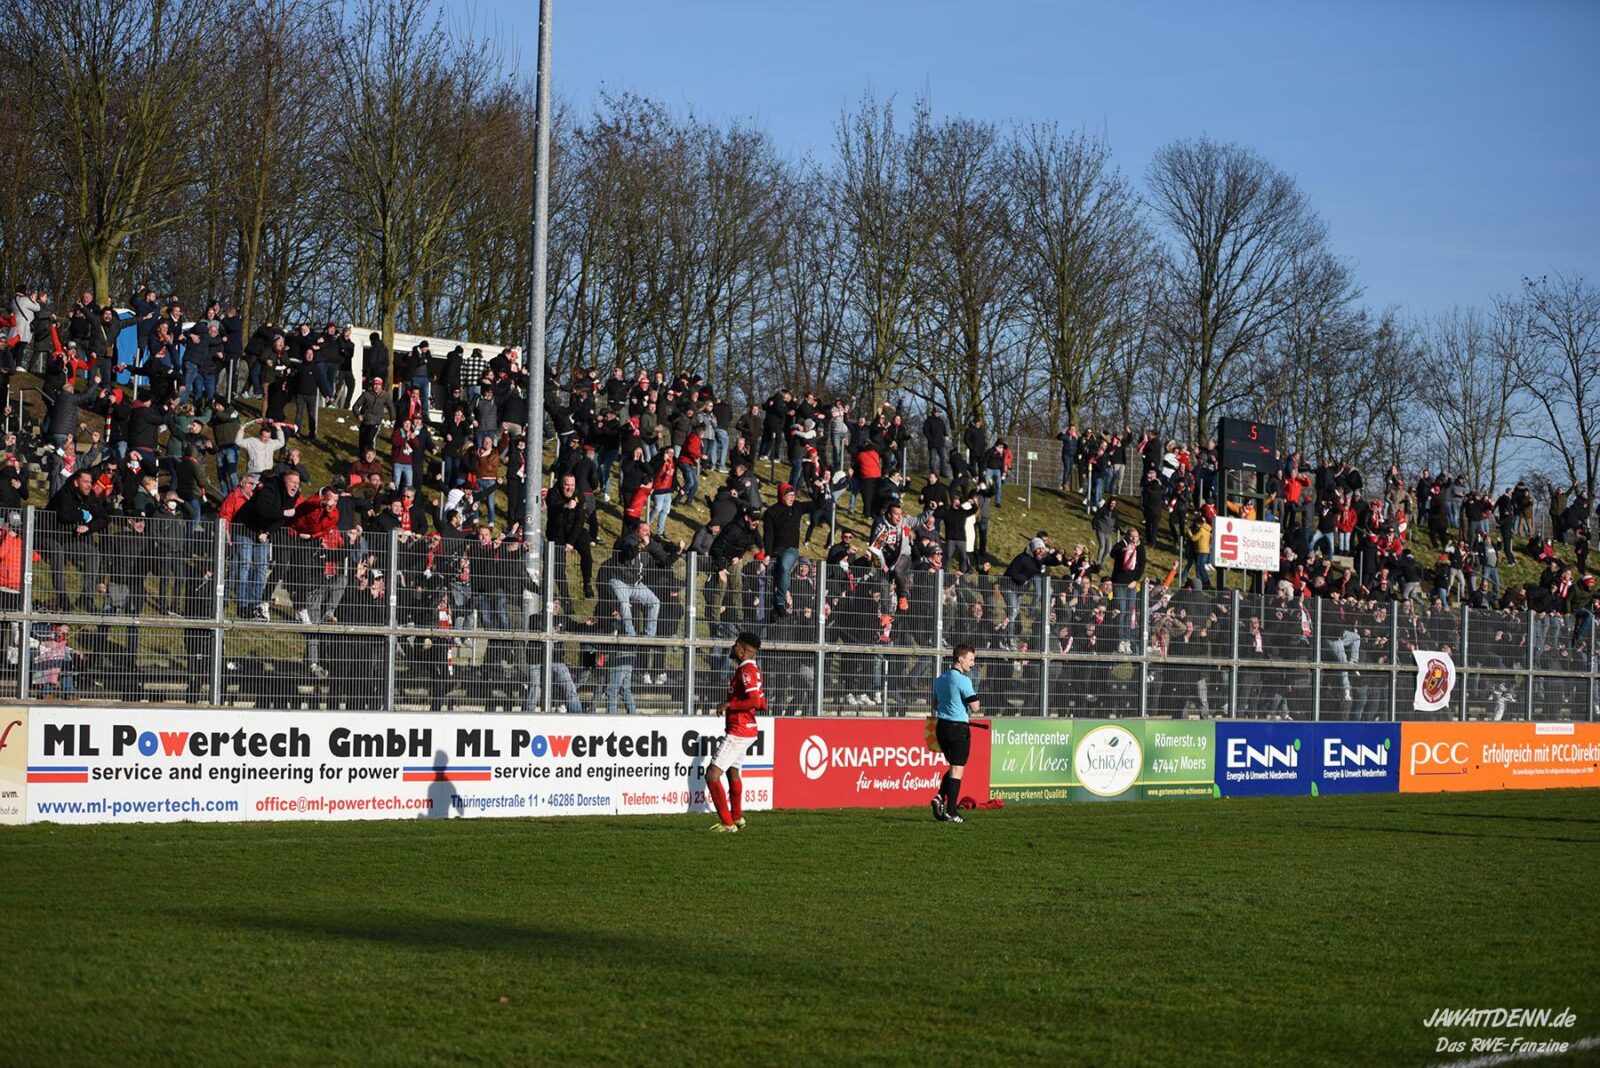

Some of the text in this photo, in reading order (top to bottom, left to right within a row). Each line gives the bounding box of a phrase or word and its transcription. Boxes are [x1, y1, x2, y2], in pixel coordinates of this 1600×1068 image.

[1242, 536, 1276, 550] Sparkasse
[43, 724, 100, 757] ML
[112, 724, 311, 757] Powertech
[328, 727, 433, 758] GmbH
[456, 728, 765, 758] ML Powertech GmH
[991, 728, 1070, 745] Ihr Gartencenter
[1155, 732, 1207, 750] Römerstr. 19
[831, 747, 950, 768] KNAPPSCHA
[1002, 745, 1069, 774] in Moers
[1152, 757, 1207, 773] 47447 Moers
[1483, 743, 1532, 768] Erfolgreich
[1534, 744, 1550, 762] mit
[92, 763, 400, 784] service and engineering for power
[494, 763, 550, 779] service
[555, 763, 582, 779] and
[586, 762, 670, 781] engineering
[674, 762, 696, 777] for
[1226, 770, 1245, 782] Energie
[1250, 770, 1269, 780] Umwelt
[1269, 770, 1298, 780] Niederrhein
[1323, 769, 1340, 781] Energie
[1344, 769, 1361, 778] Umwelt
[856, 771, 872, 792] für
[874, 775, 900, 791] meine
[451, 793, 611, 812] Thüringerstraße 11 46286 Dorsten
[622, 792, 659, 806] Telefon:
[661, 791, 678, 805] +49
[680, 791, 692, 806] (0)
[694, 791, 706, 804] 23
[745, 789, 756, 803] 83
[757, 789, 769, 802] 56
[990, 789, 1068, 801] Erfahrung erkennt Qualität
[37, 795, 433, 817] www.ml-powertech.com office@ml-powertech.com
